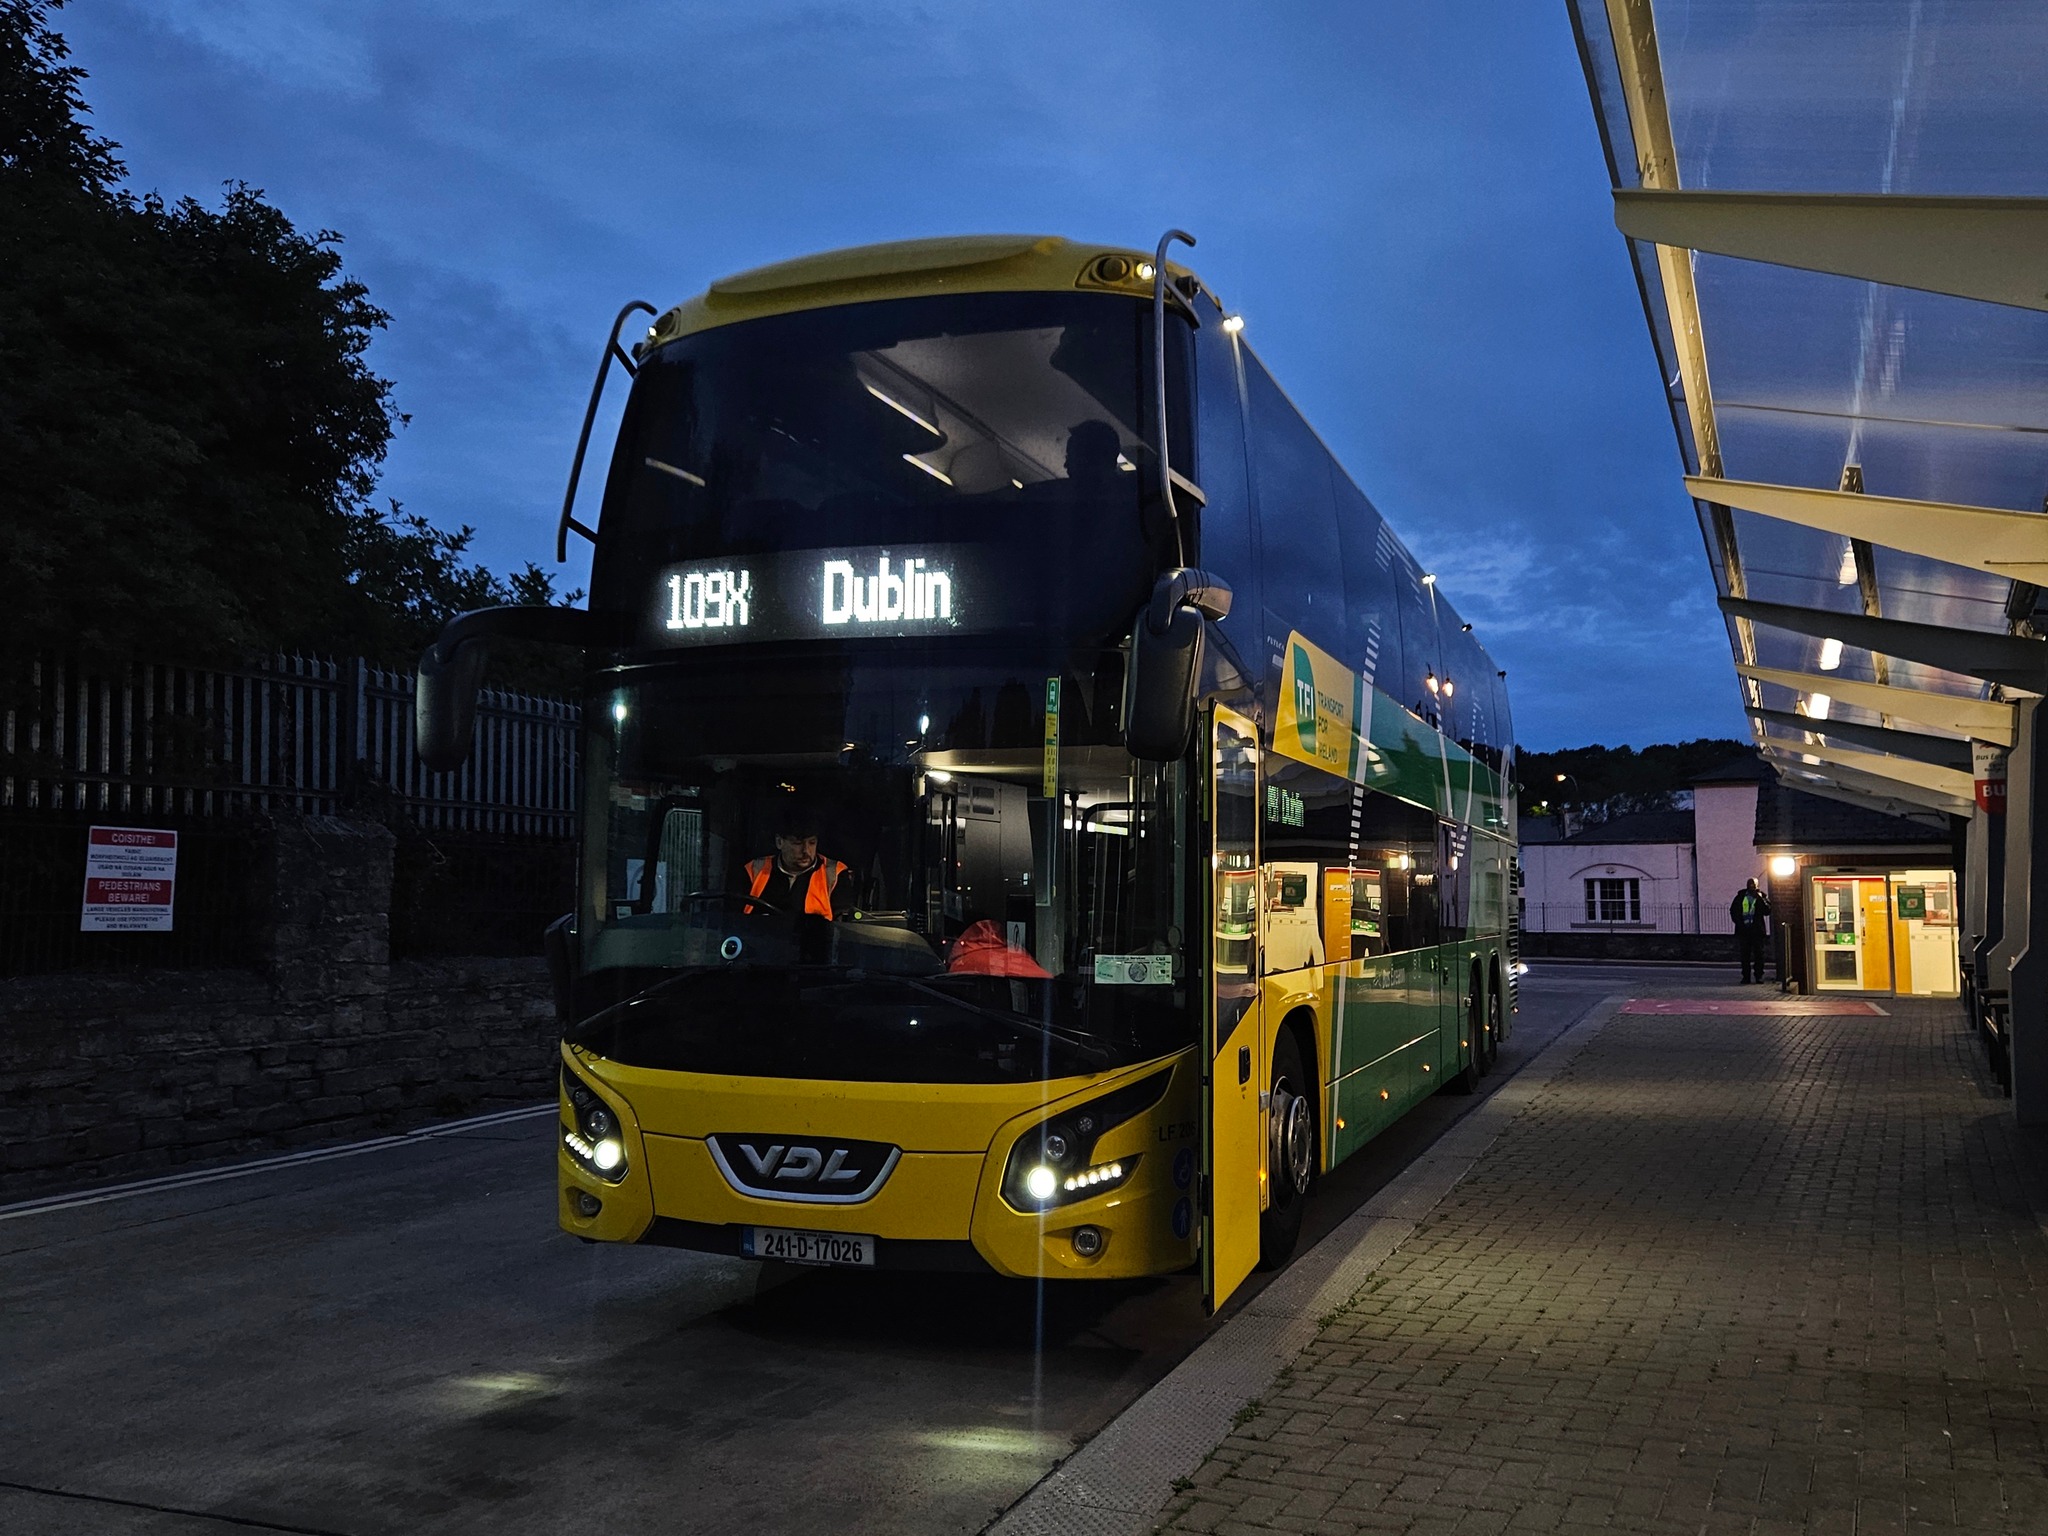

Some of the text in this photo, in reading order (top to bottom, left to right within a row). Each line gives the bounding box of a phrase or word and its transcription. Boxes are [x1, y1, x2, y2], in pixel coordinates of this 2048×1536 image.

[665, 556, 951, 629] 109X Dublin
[1297, 679, 1314, 720] TFI
[1317, 690, 1345, 718] TRANSPORT
[1318, 716, 1329, 734] FOR
[1319, 742, 1338, 764] IRELAND
[1983, 785, 2006, 797] BU
[98, 880, 161, 892] PEDESTRIANS
[107, 892, 150, 903] BEWARE!
[1159, 1124, 1175, 1142] LF
[738, 1143, 861, 1182] VDL
[763, 1233, 863, 1263] 241-D-17026
